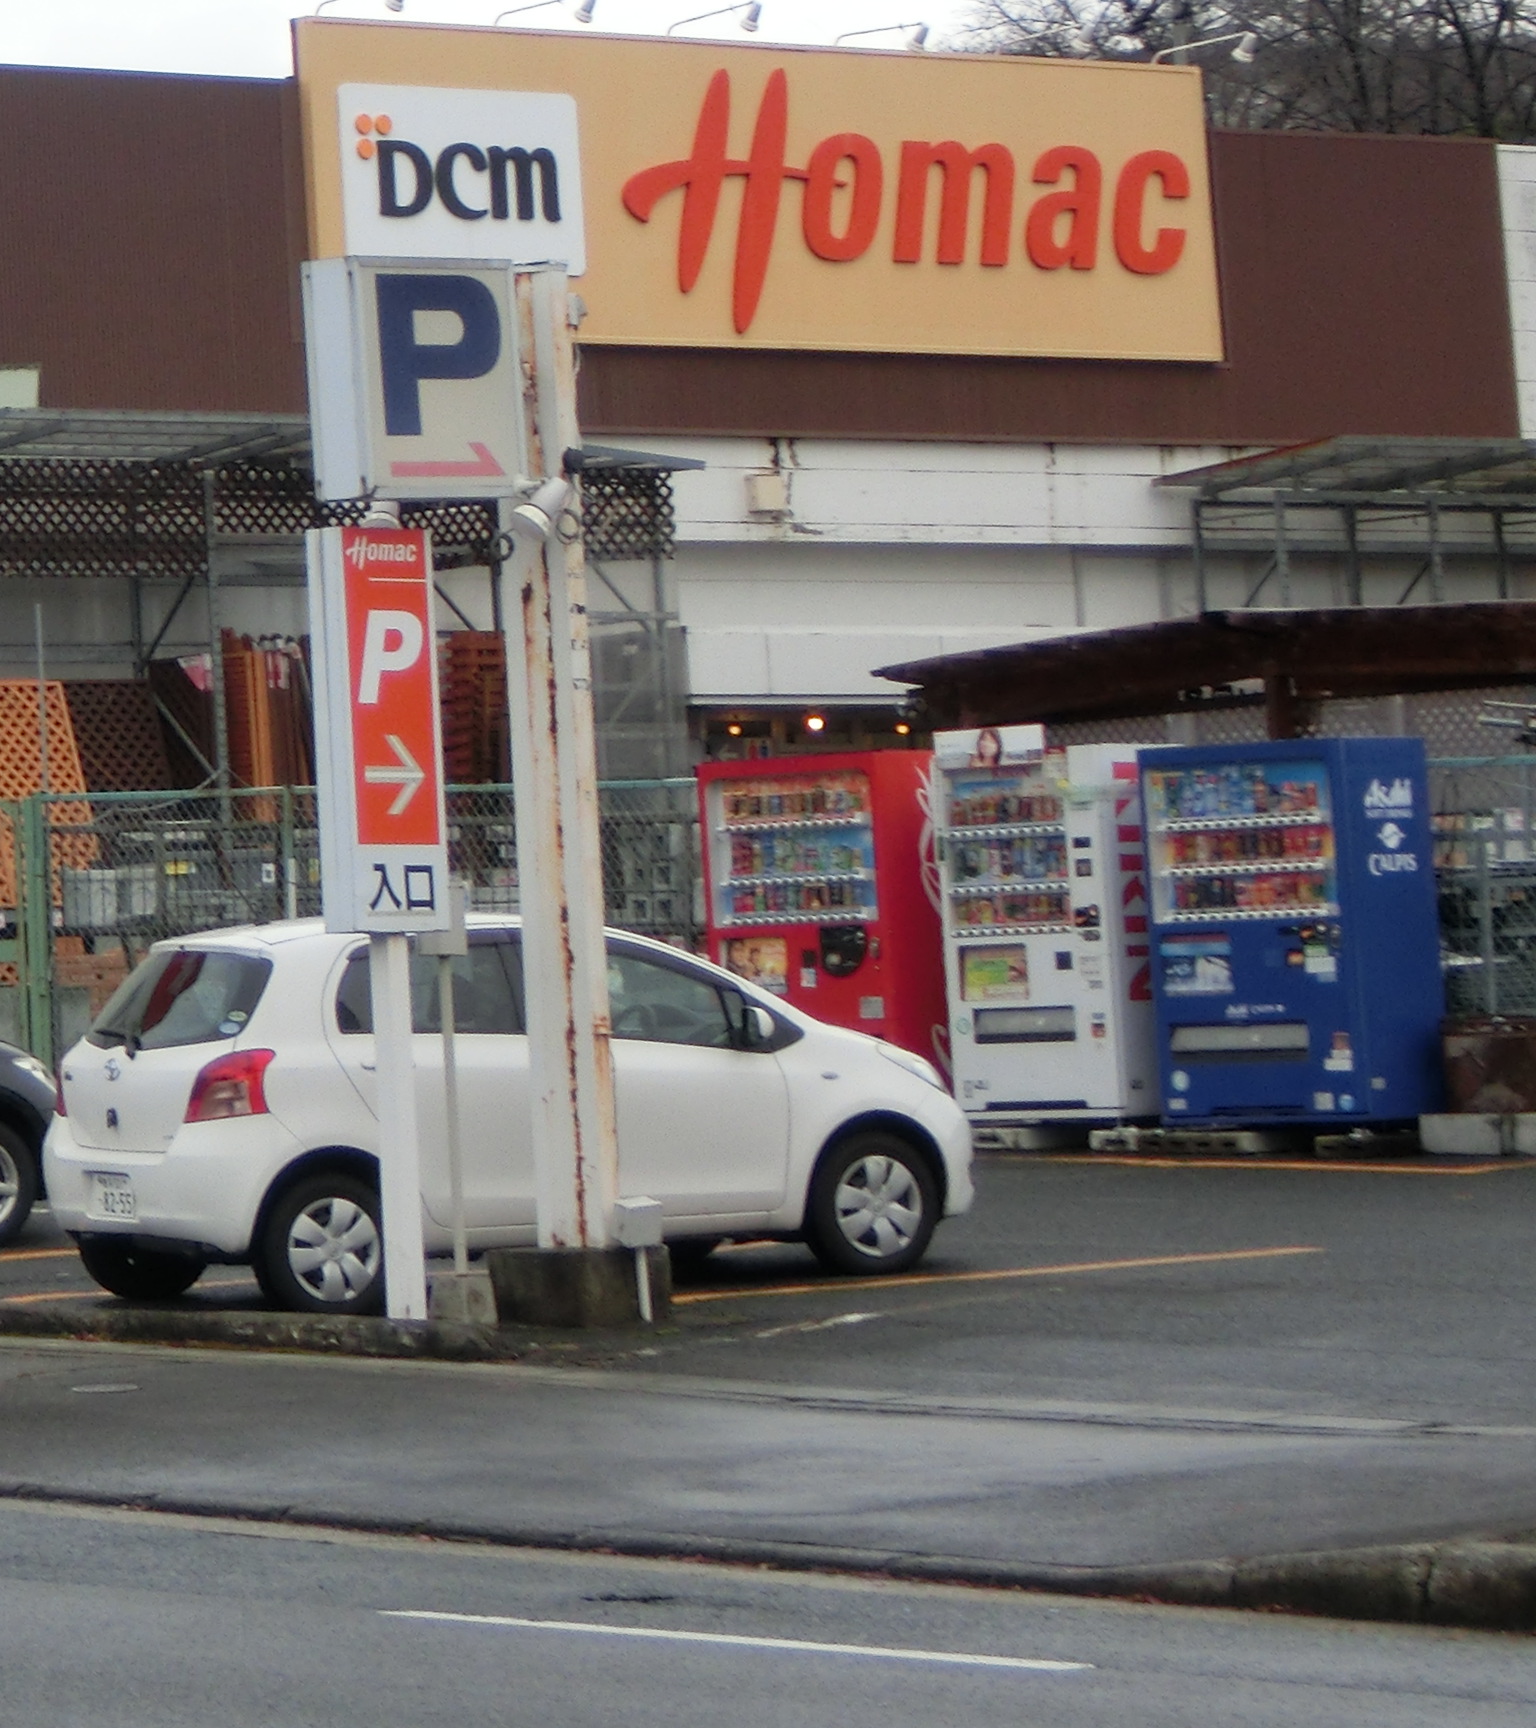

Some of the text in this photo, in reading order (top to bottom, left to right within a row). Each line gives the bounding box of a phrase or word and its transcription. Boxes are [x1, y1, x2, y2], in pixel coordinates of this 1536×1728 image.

[622, 68, 1190, 334] Homac
[375, 273, 501, 436] P
[345, 535, 418, 570] Homac
[357, 609, 423, 704] P
[369, 863, 435, 911] 入口
